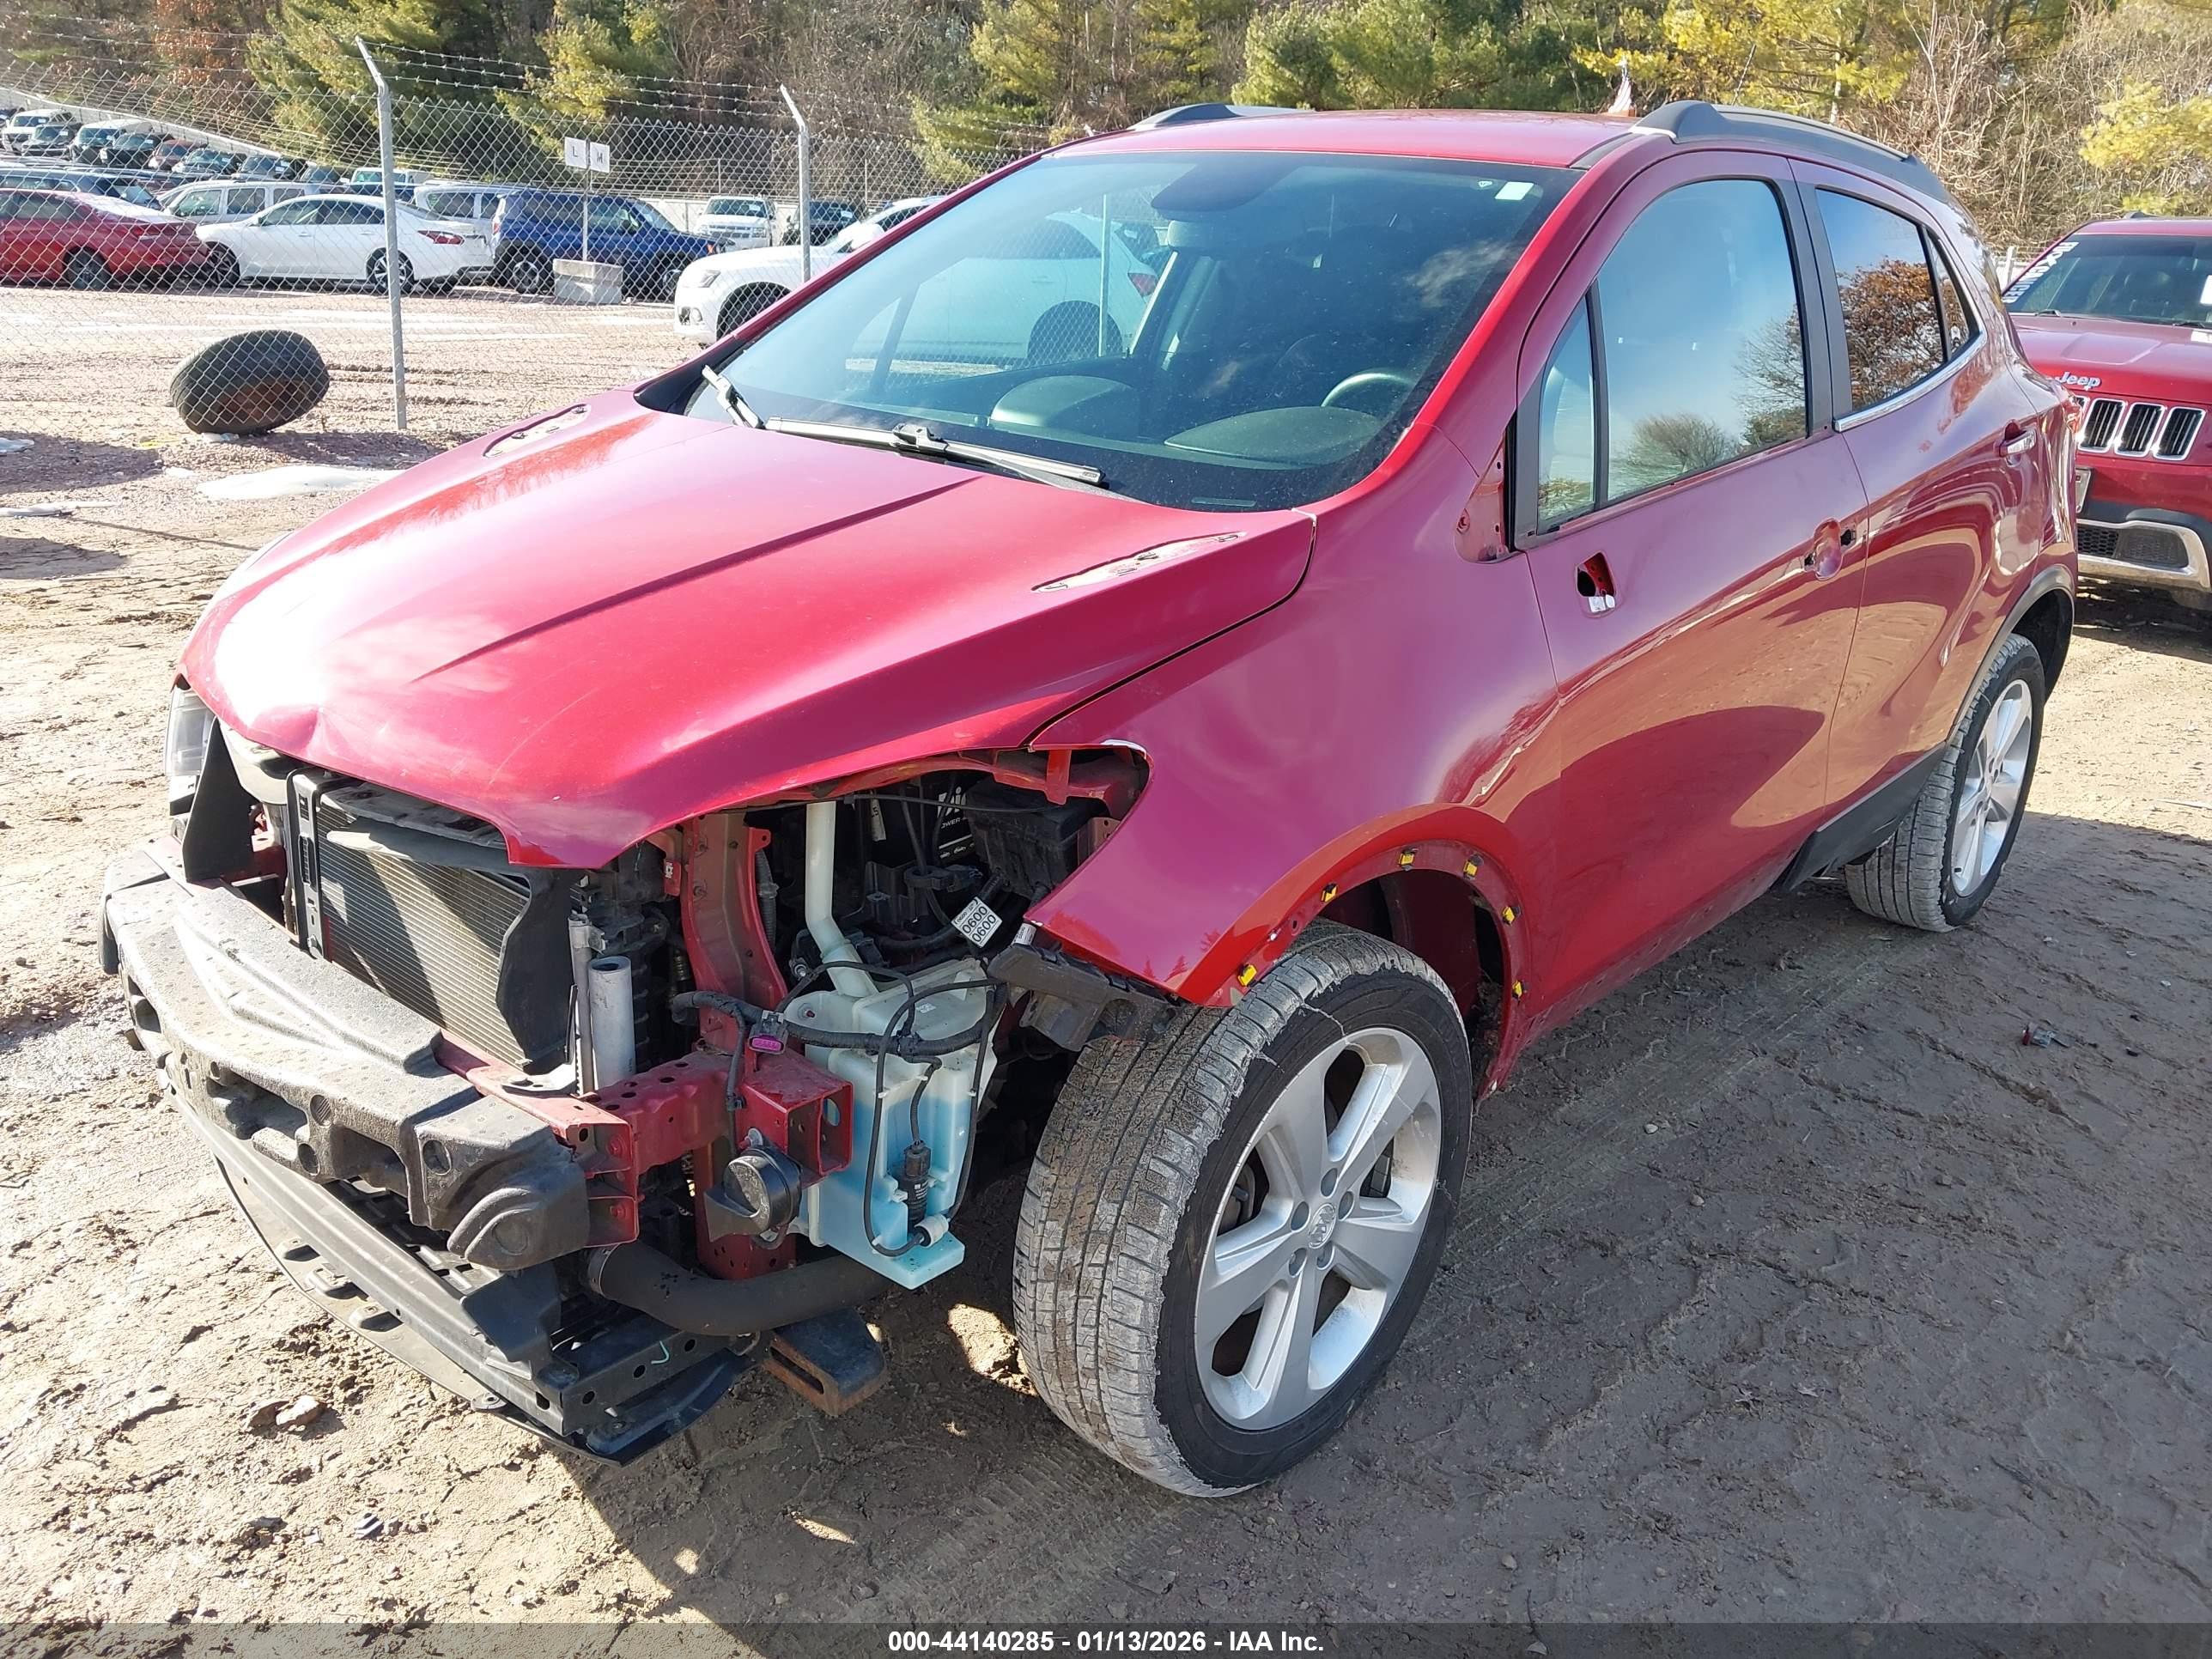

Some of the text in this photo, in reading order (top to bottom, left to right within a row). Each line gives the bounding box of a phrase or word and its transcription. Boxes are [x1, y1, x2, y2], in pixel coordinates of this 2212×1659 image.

[2054, 370, 2102, 389] Jeep
[962, 906, 988, 934] 0600
[971, 914, 997, 943] 0600
